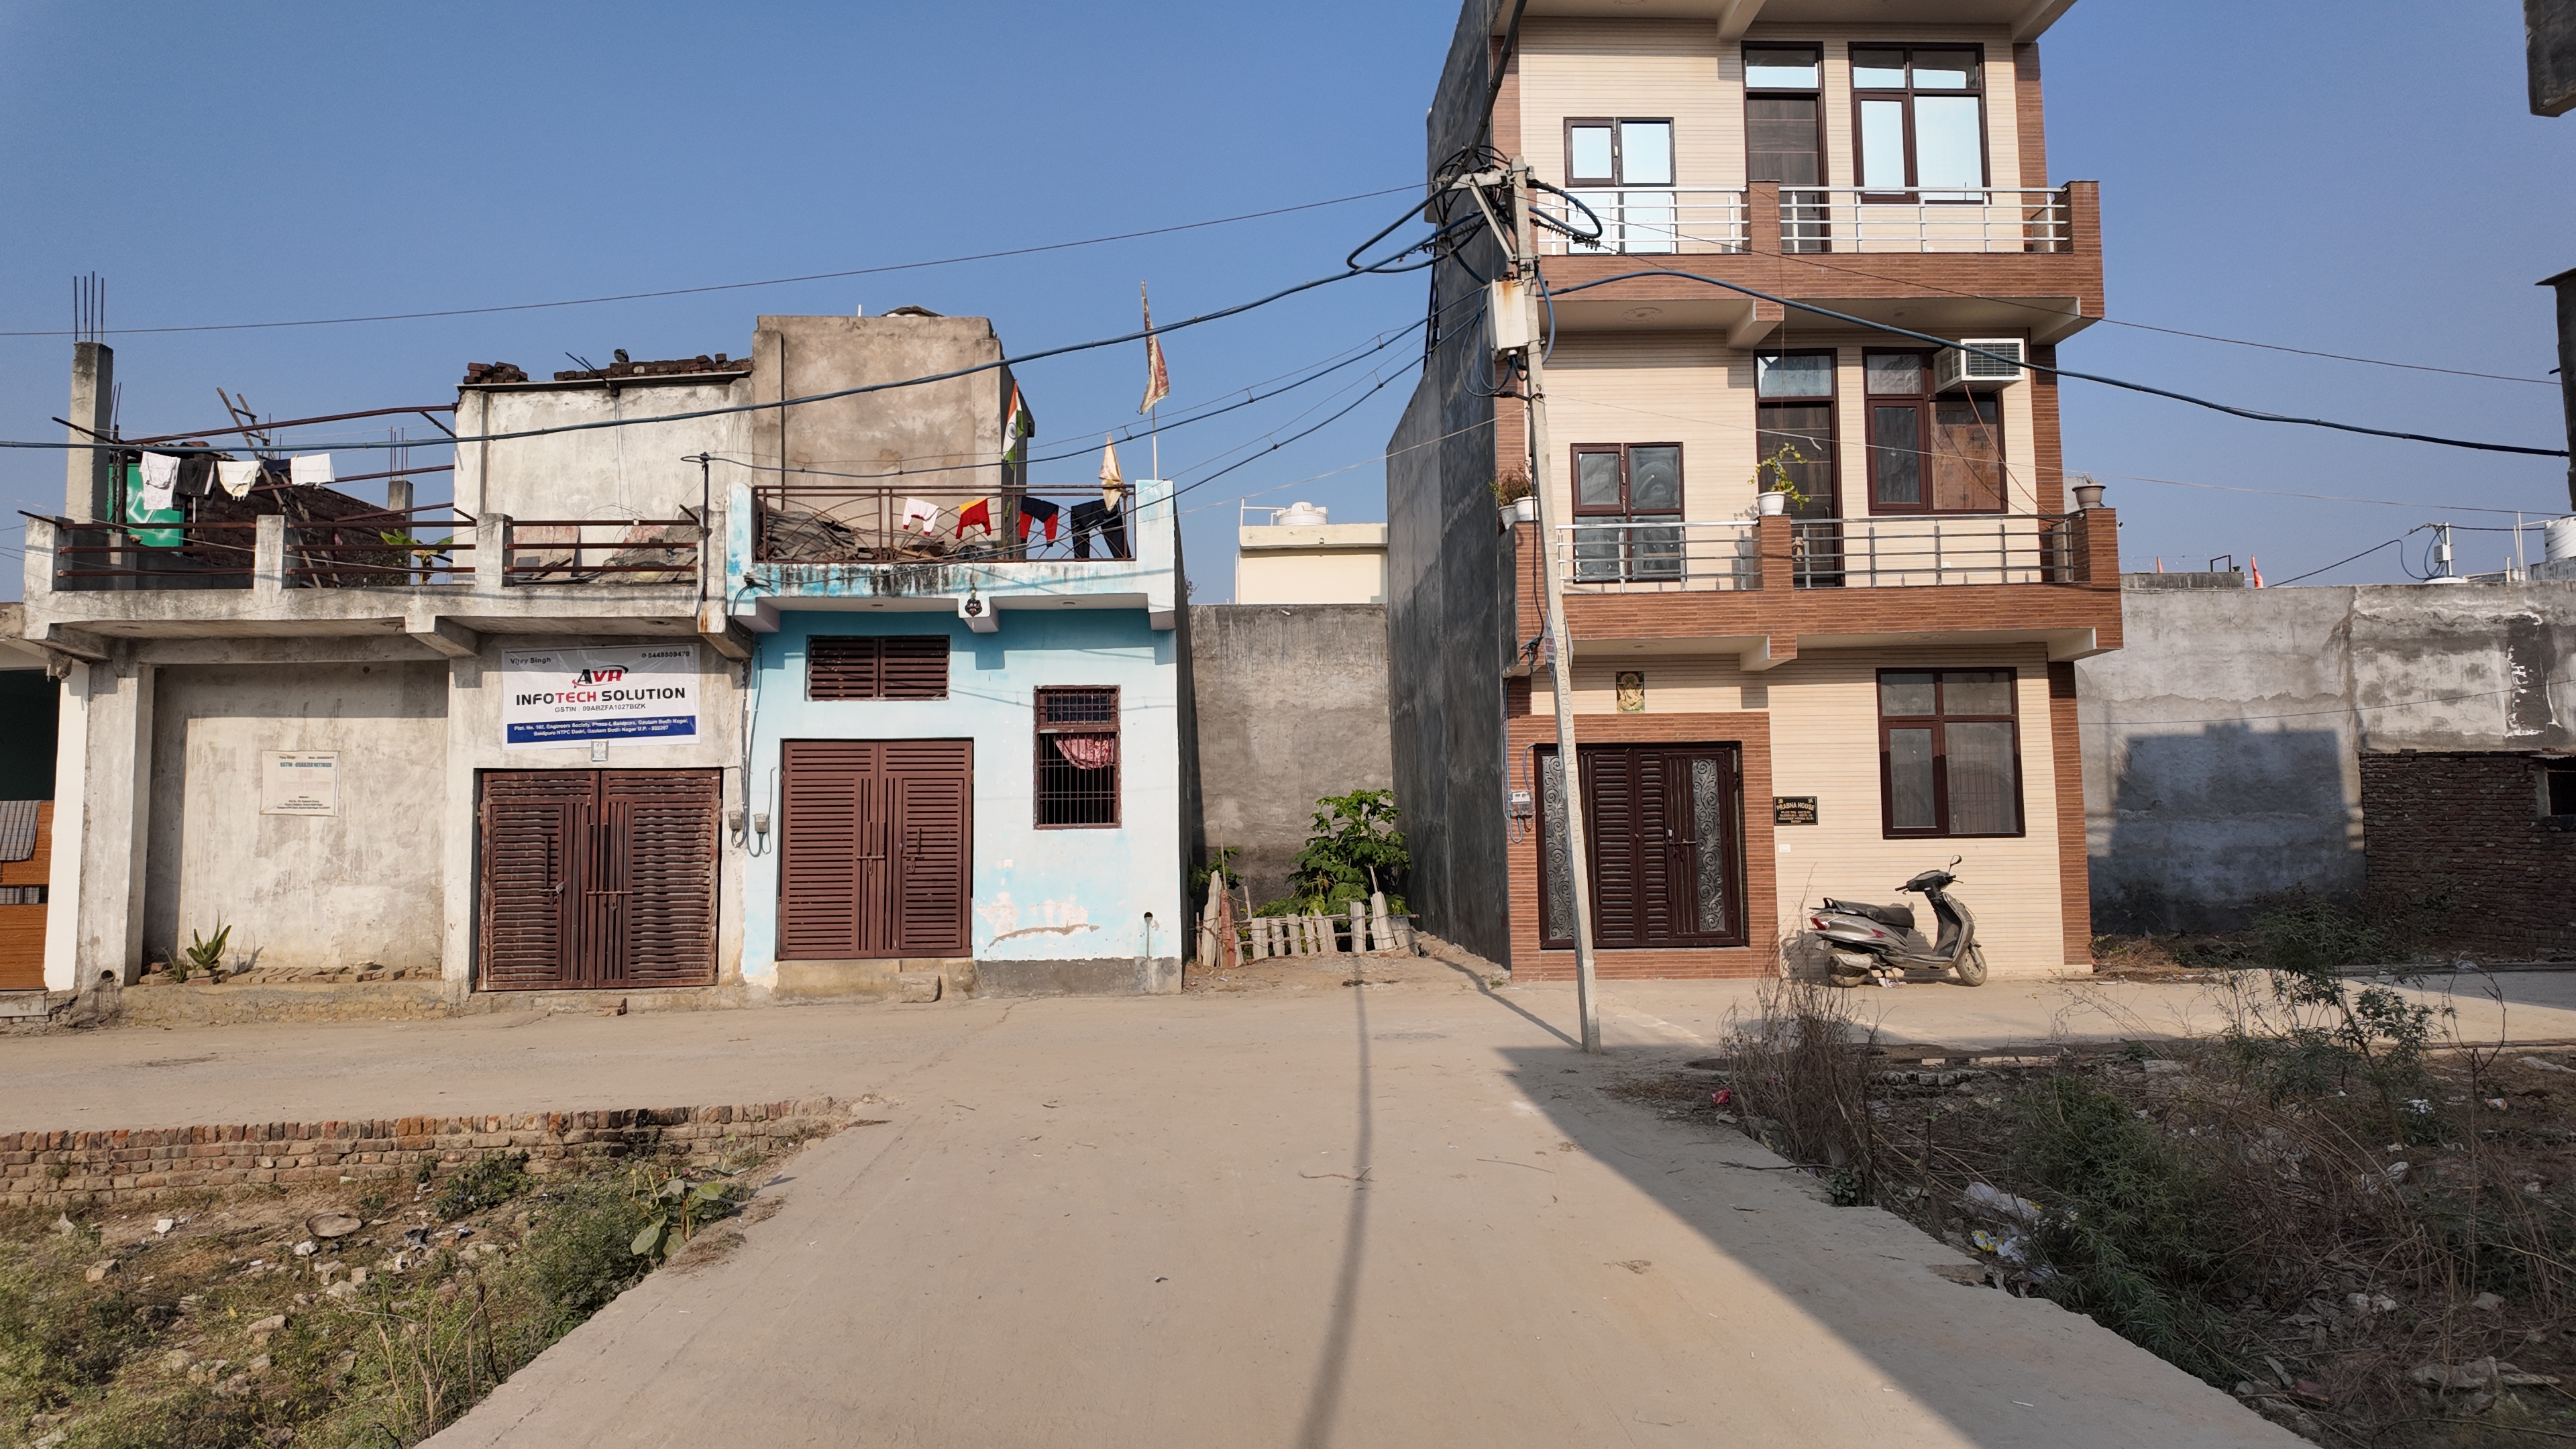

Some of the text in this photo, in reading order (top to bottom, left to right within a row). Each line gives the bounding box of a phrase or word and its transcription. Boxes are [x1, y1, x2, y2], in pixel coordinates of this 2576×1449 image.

[530, 656, 551, 665] Singh
[576, 669, 623, 686] AVR
[516, 687, 686, 706] INFOTECH SOLUTION
[1797, 802, 1815, 810] HOUSE
